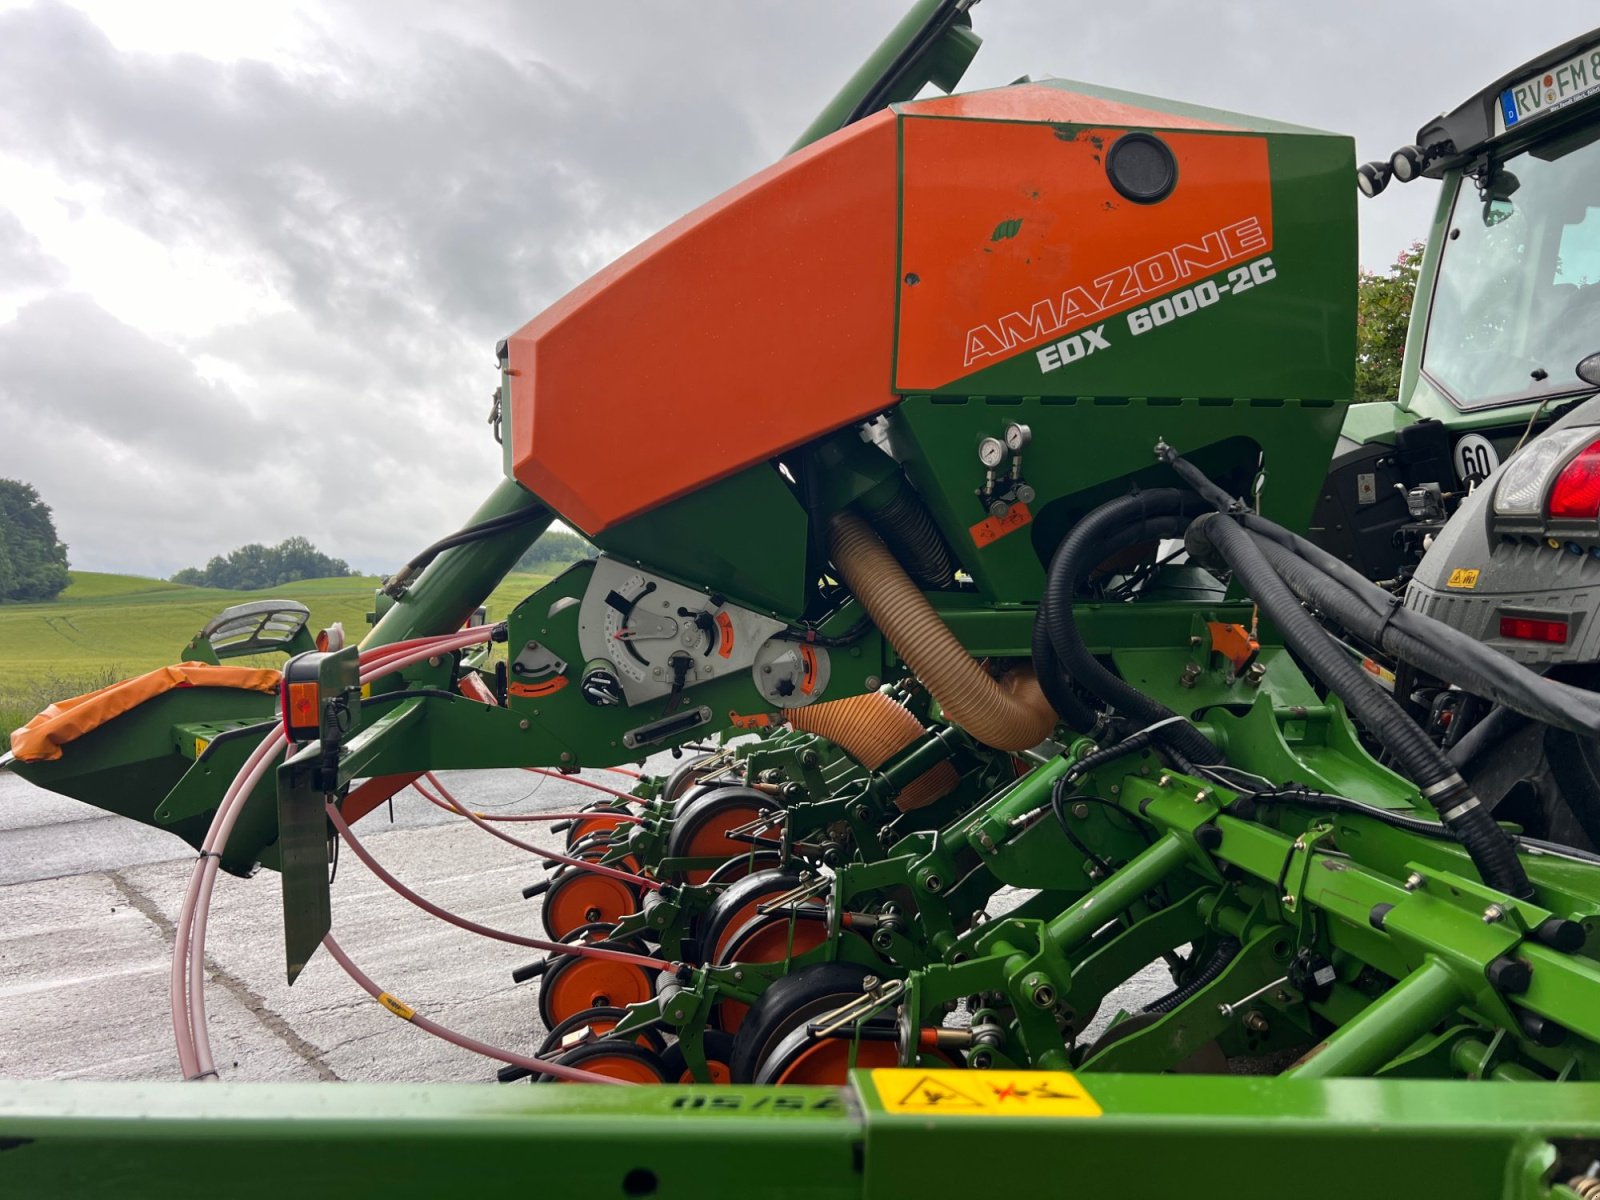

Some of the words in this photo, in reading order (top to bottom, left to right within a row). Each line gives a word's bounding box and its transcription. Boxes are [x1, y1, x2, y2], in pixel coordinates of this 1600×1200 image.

[1514, 80, 1541, 116] RV
[1556, 59, 1588, 97] FM
[963, 216, 1267, 367] AMAZONE
[1035, 323, 1111, 374] EDX
[1126, 256, 1277, 336] 6000-2C
[1461, 444, 1491, 480] 60
